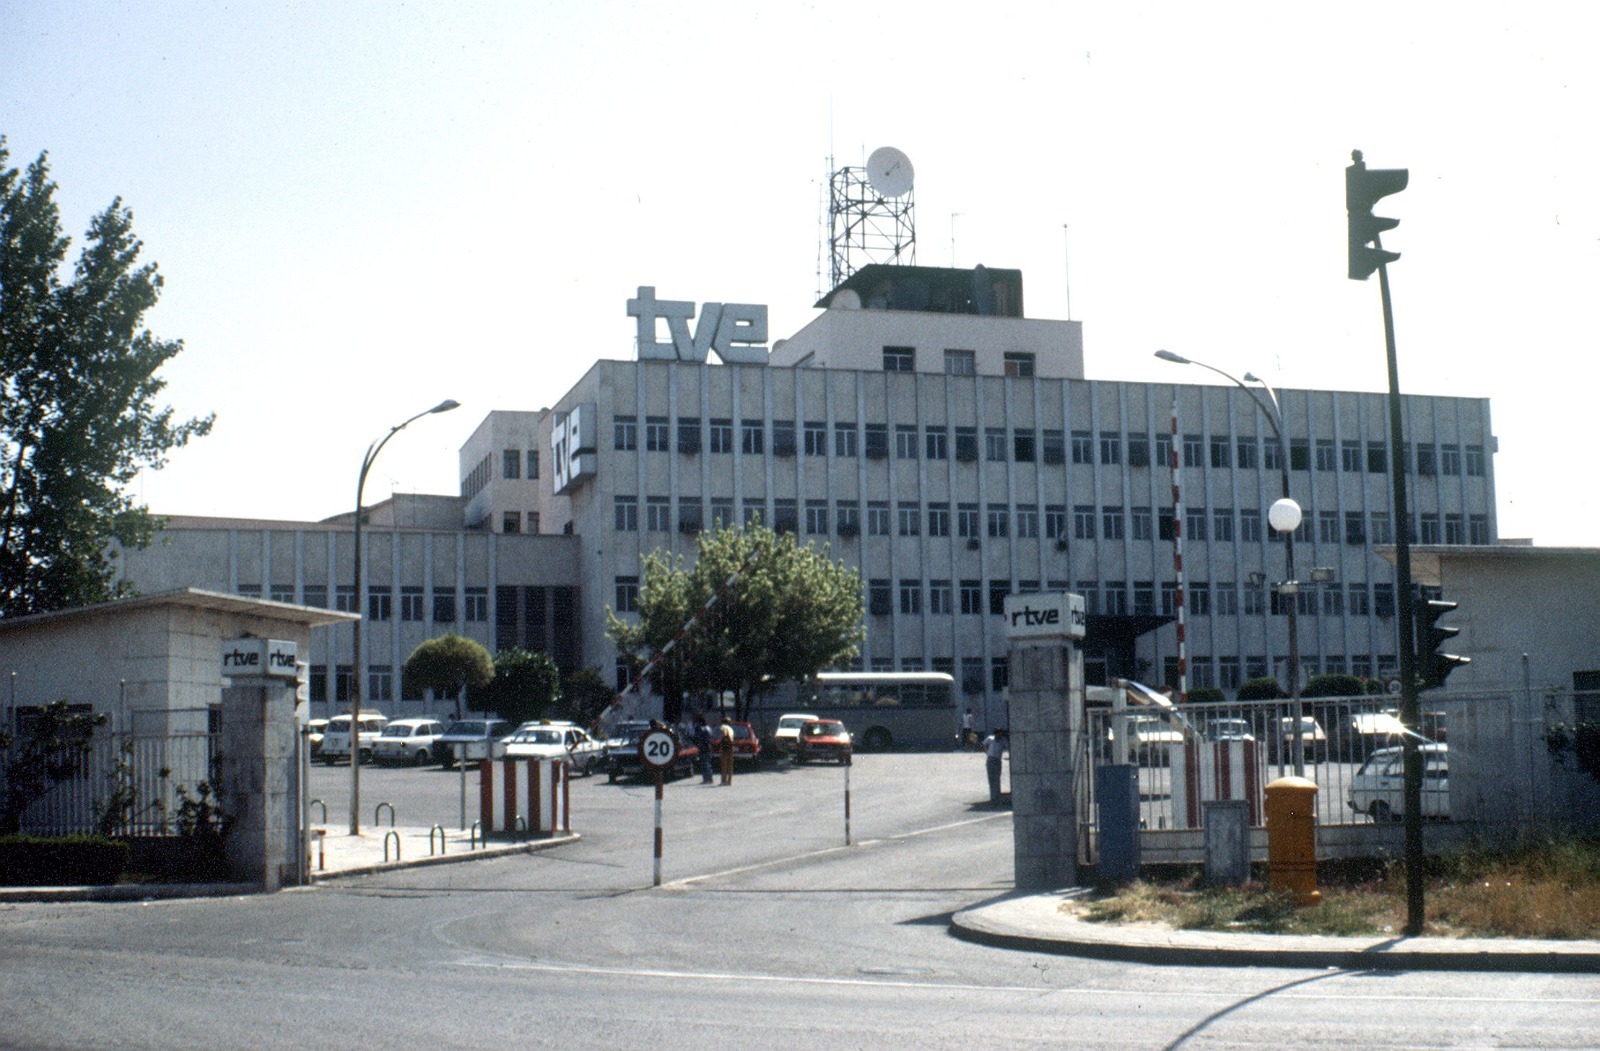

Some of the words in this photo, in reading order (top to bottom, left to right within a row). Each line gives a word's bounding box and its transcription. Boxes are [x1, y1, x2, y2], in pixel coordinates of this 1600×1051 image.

[627, 286, 769, 364] tve
[551, 405, 584, 494] tve
[1011, 605, 1059, 627] rtve
[223, 649, 260, 666] rtve
[270, 649, 296, 667] rtve
[648, 740, 670, 757] 20
